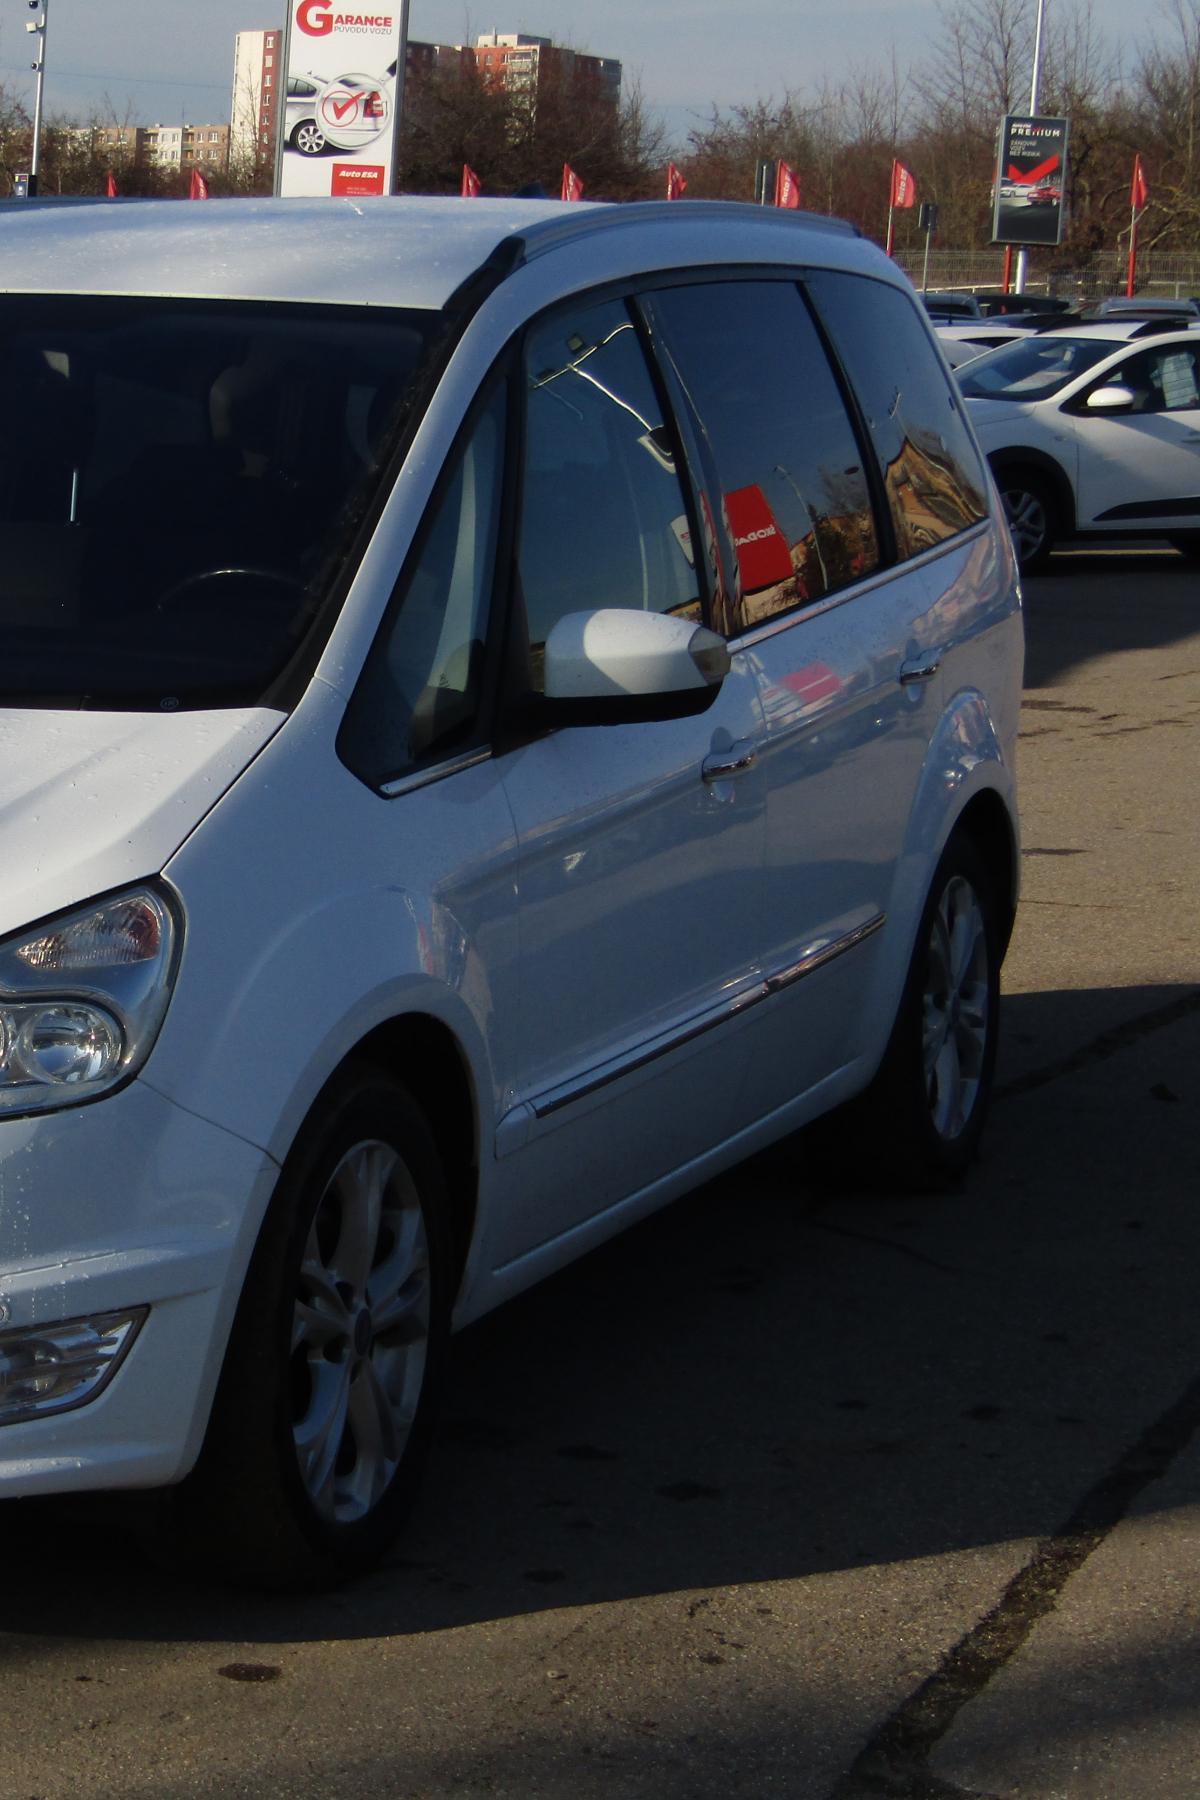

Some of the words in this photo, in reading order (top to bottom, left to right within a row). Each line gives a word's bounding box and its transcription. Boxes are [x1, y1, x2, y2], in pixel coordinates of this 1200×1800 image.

[296, 0, 392, 37] GARANCE
[339, 170, 361, 178] Auto
[361, 171, 378, 179] ESA
